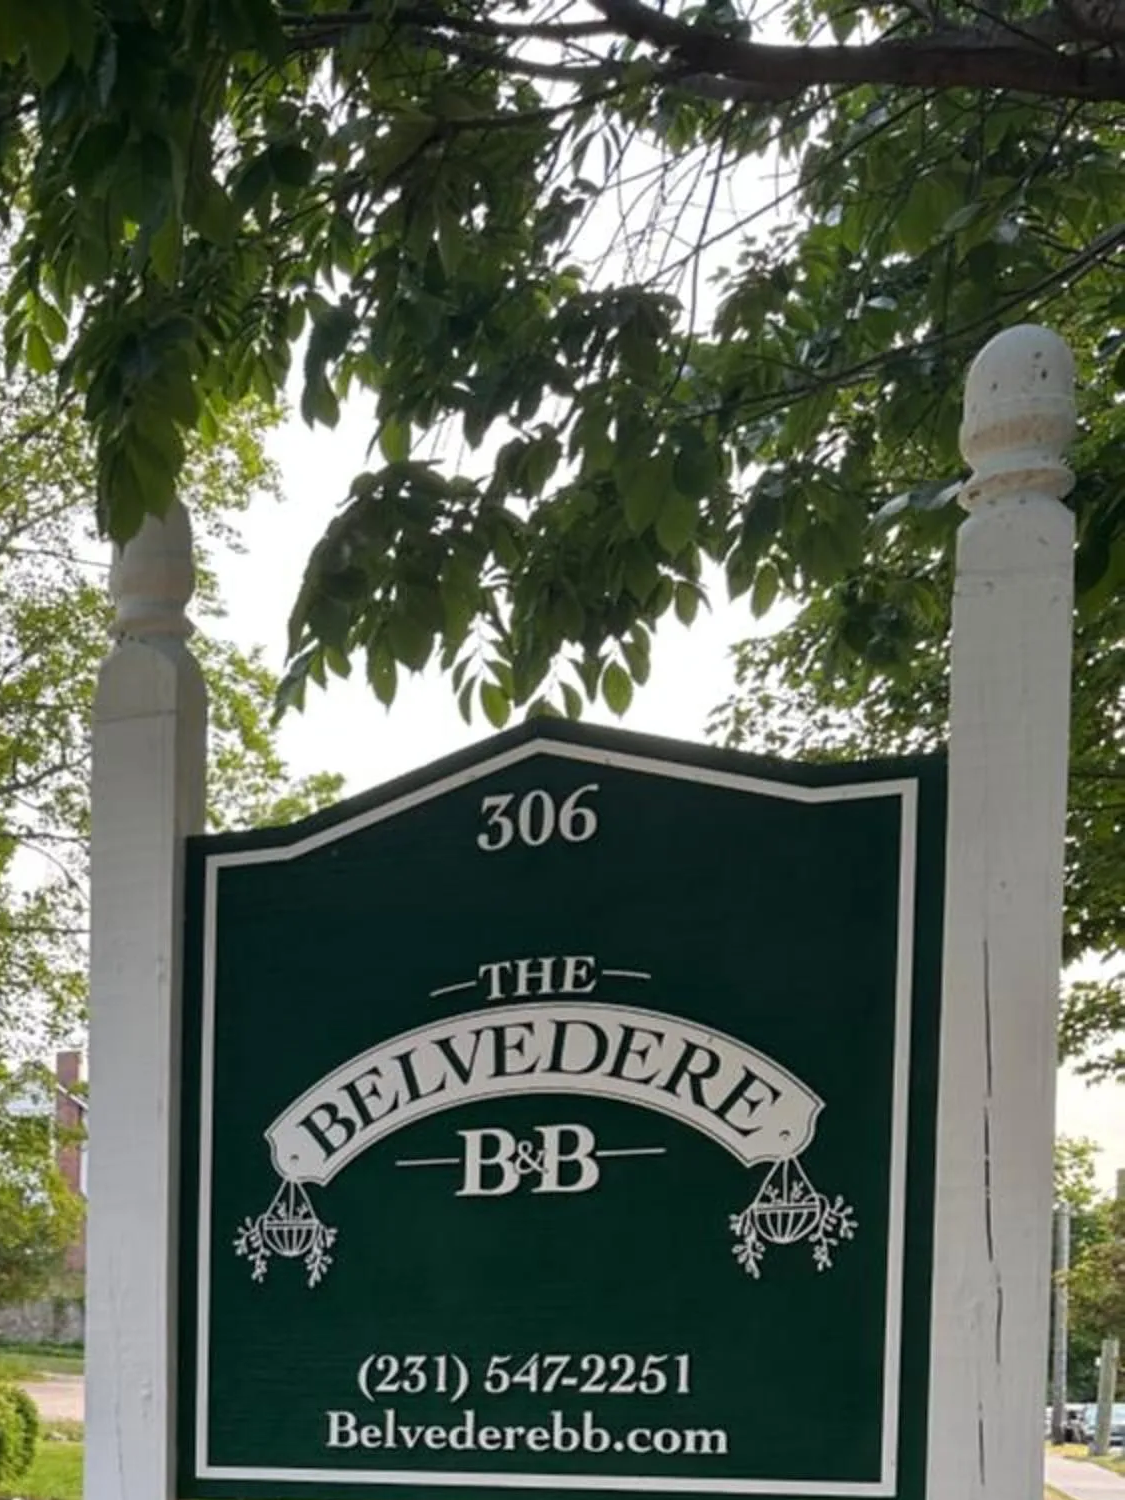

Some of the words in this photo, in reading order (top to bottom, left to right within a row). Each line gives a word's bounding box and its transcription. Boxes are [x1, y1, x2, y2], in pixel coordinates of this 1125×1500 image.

[476, 783, 600, 851] 306
[478, 955, 597, 1001] THE
[298, 1019, 781, 1163] BELVEDERE
[455, 1123, 602, 1198] B&B
[357, 1354, 469, 1402] (231)
[483, 1353, 693, 1395] 547-2251
[325, 1409, 729, 1456] Belvederebb.com
